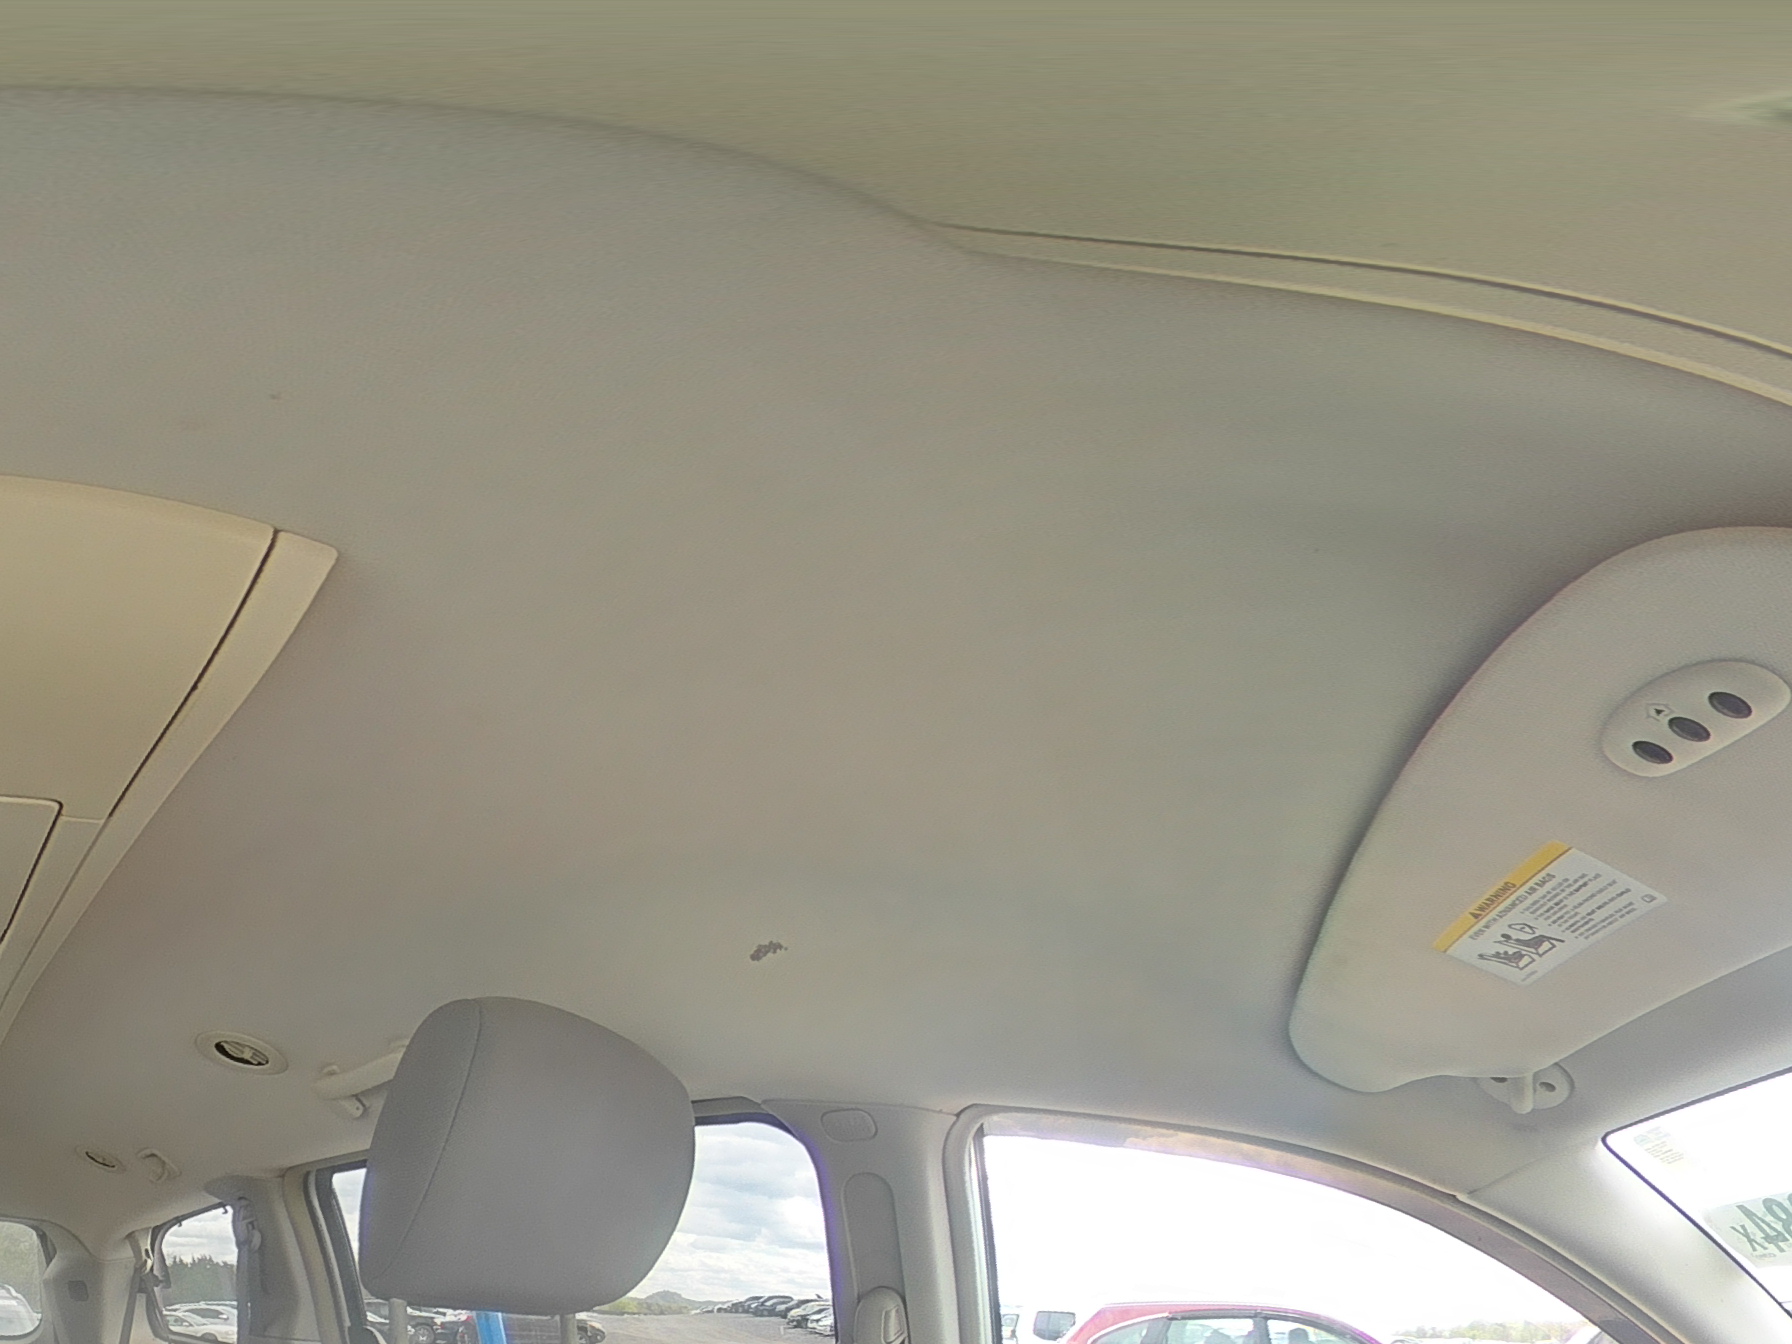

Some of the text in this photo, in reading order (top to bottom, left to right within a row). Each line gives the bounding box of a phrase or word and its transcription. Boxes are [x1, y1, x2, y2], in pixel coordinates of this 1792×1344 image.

[1474, 881, 1517, 913] WARNING
[1496, 894, 1529, 919] ADVANCED
[1534, 872, 1557, 888] BAGS
